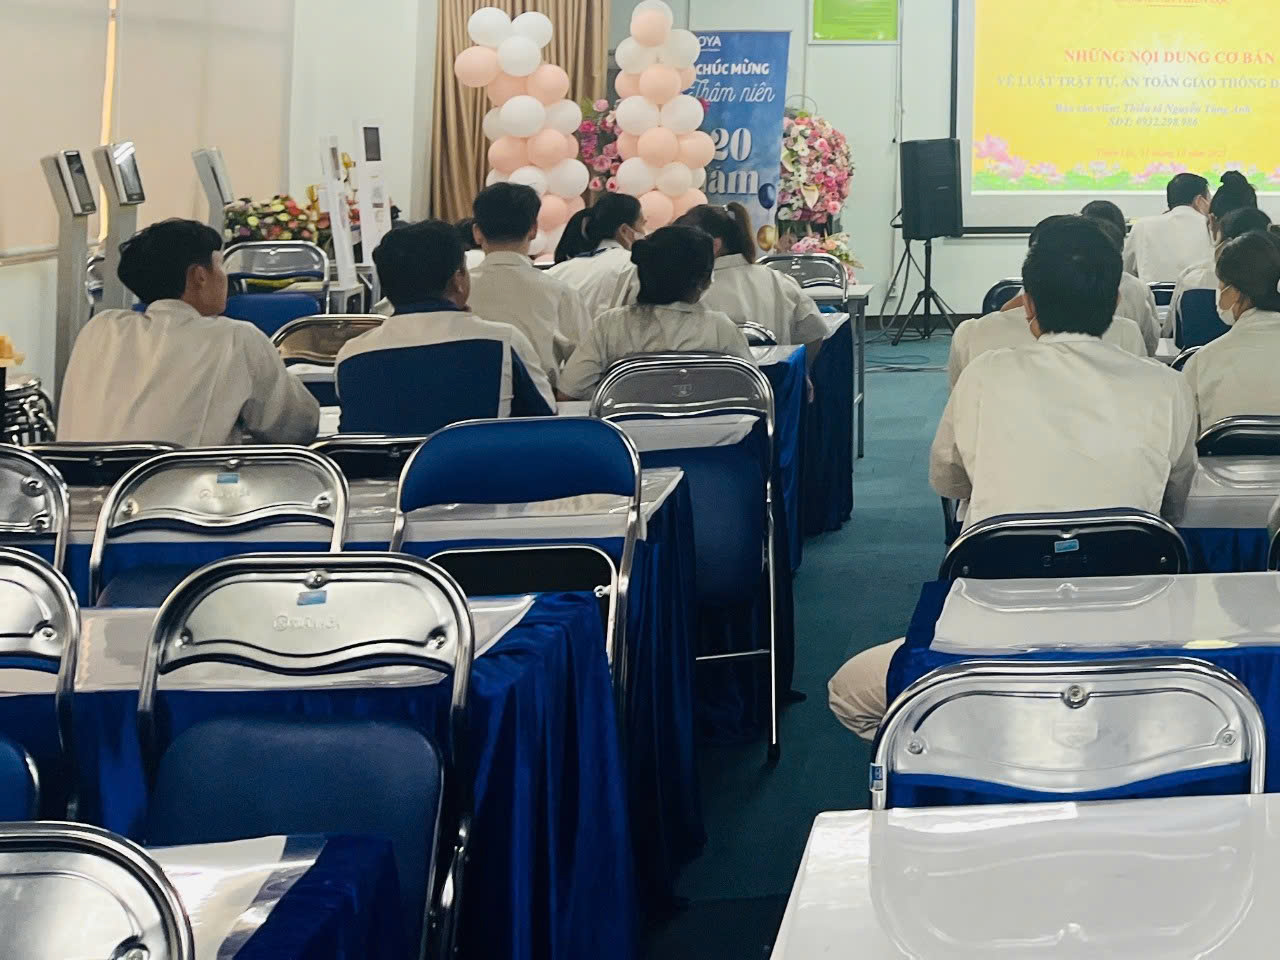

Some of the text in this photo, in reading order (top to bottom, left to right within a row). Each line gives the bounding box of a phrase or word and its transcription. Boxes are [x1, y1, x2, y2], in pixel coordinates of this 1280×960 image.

[696, 34, 722, 47] OYA
[1064, 48, 1124, 64] NHỮNG
[1129, 48, 1159, 66] NỘI
[1164, 51, 1210, 64] DUNG
[1214, 51, 1239, 64] CƠ
[695, 58, 770, 75] CHÚC MỪNG
[1120, 76, 1139, 88] AN
[1143, 73, 1180, 88] TOÀN
[1182, 77, 1217, 88] GIAO
[1219, 74, 1267, 89] THÔNG
[694, 79, 776, 102] Thâm niên
[711, 127, 752, 162] 20
[708, 166, 759, 194] ăm
